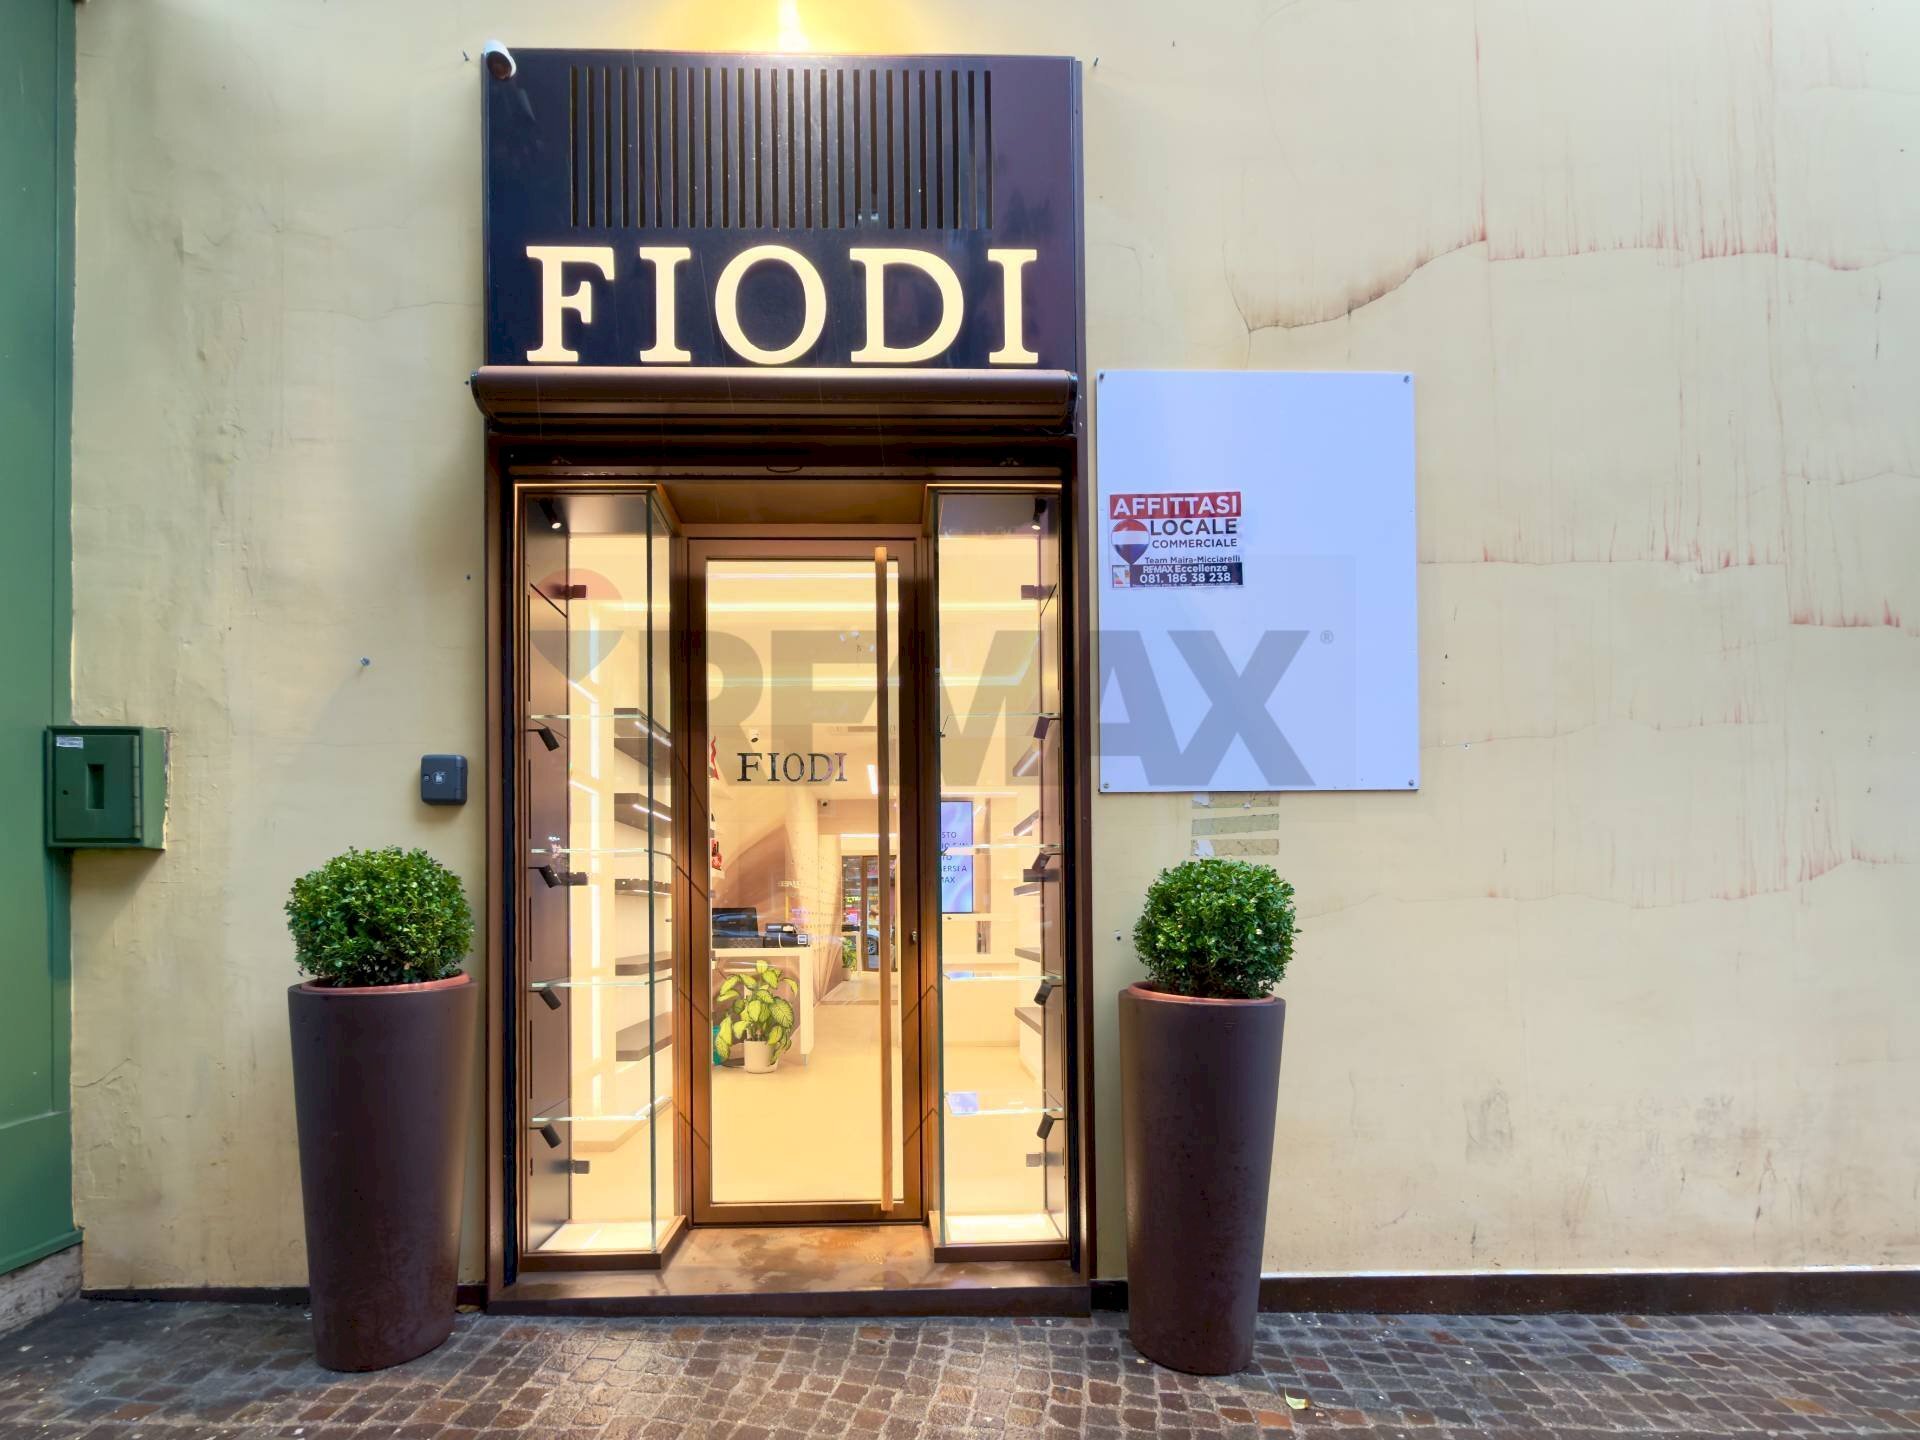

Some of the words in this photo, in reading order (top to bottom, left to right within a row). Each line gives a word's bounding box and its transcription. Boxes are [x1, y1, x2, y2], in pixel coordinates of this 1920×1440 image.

[525, 244, 1040, 365] FIODI
[1113, 495, 1238, 516] AFFITTASI
[1150, 518, 1238, 536] LOCALE
[1152, 538, 1238, 549] COMMERCIALE
[1144, 556, 1168, 564] Team
[1174, 564, 1228, 573] Eccellenze
[1139, 573, 1164, 584] 081.
[1167, 573, 1188, 583] 186
[1191, 573, 1206, 583] 38
[1209, 572, 1231, 582] 238
[736, 752, 848, 782] FIODI
